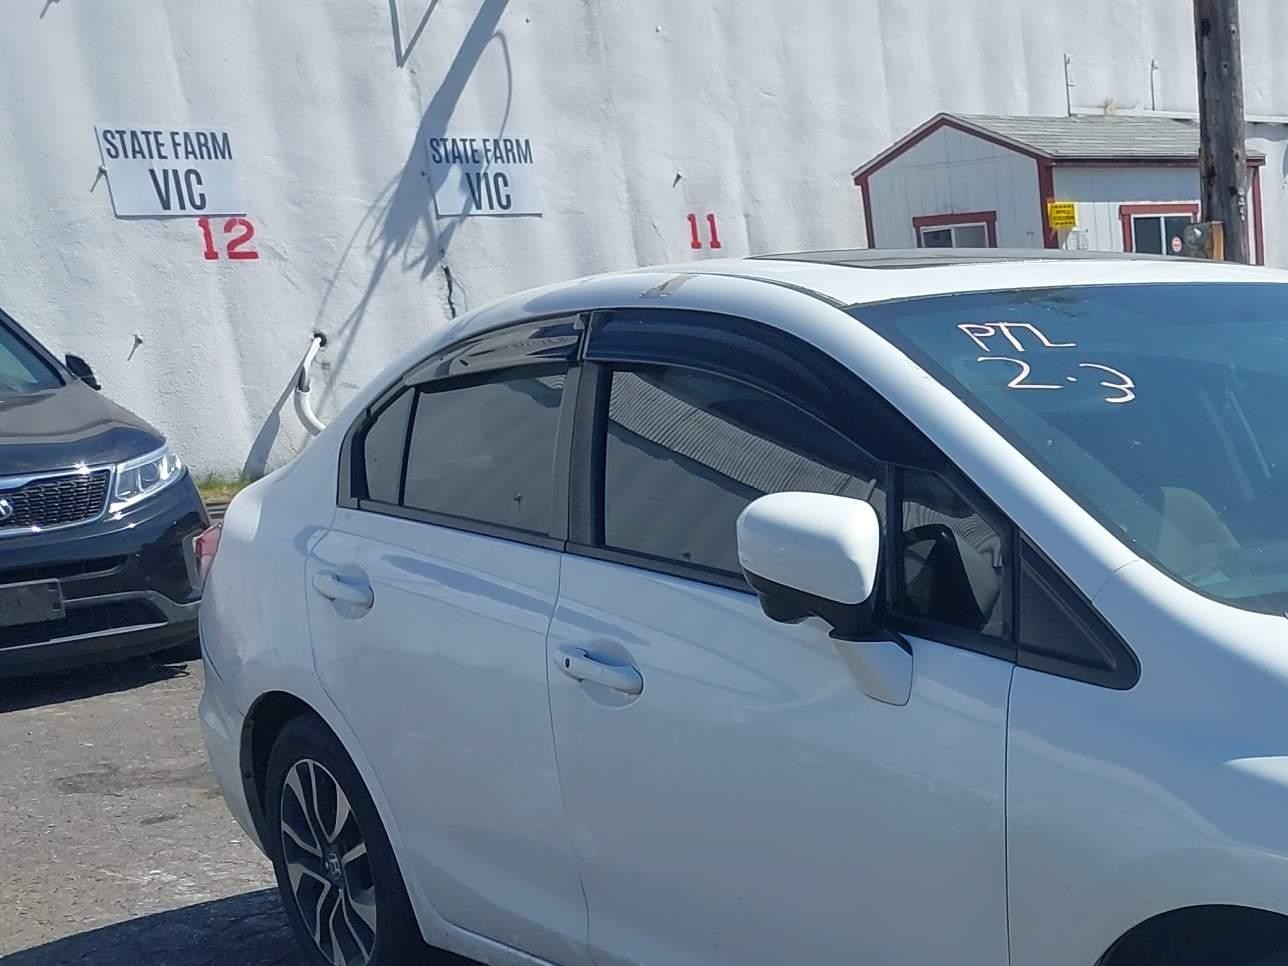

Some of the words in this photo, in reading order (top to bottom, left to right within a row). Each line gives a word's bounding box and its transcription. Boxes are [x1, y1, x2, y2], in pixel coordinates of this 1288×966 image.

[102, 129, 168, 160] STATE
[170, 131, 233, 160] FARM
[429, 137, 481, 164] STATE
[482, 138, 533, 164] FARM
[148, 168, 207, 211] VIC
[465, 172, 512, 211] VIC
[198, 216, 259, 260] 12
[687, 213, 722, 249] 11
